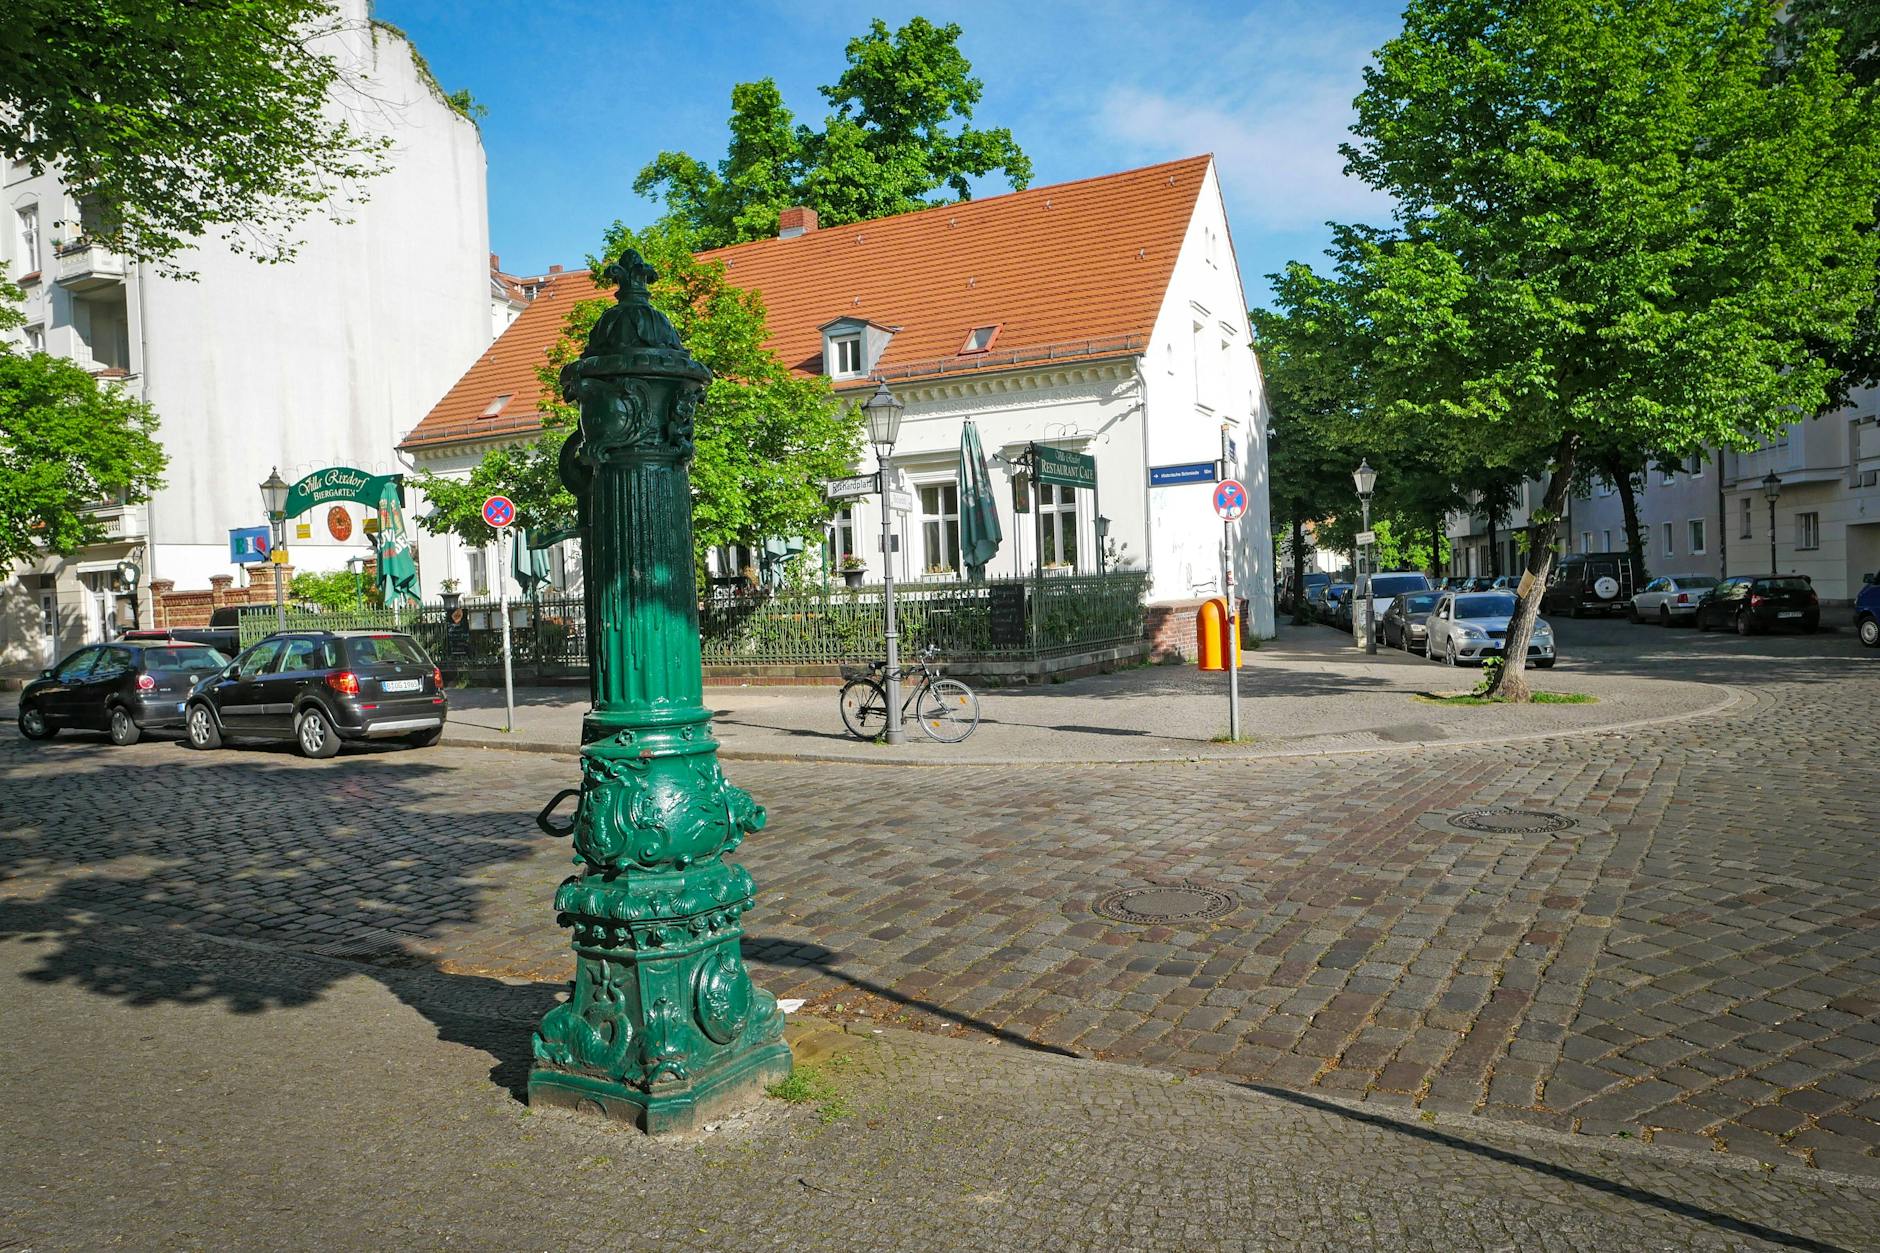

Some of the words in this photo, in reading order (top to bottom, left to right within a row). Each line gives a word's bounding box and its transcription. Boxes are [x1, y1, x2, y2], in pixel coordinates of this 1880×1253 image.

[298, 475, 323, 496] Villa
[324, 469, 370, 493] Rixdorf
[313, 488, 356, 501] BIERGARTEN
[235, 536, 266, 555] EIS
